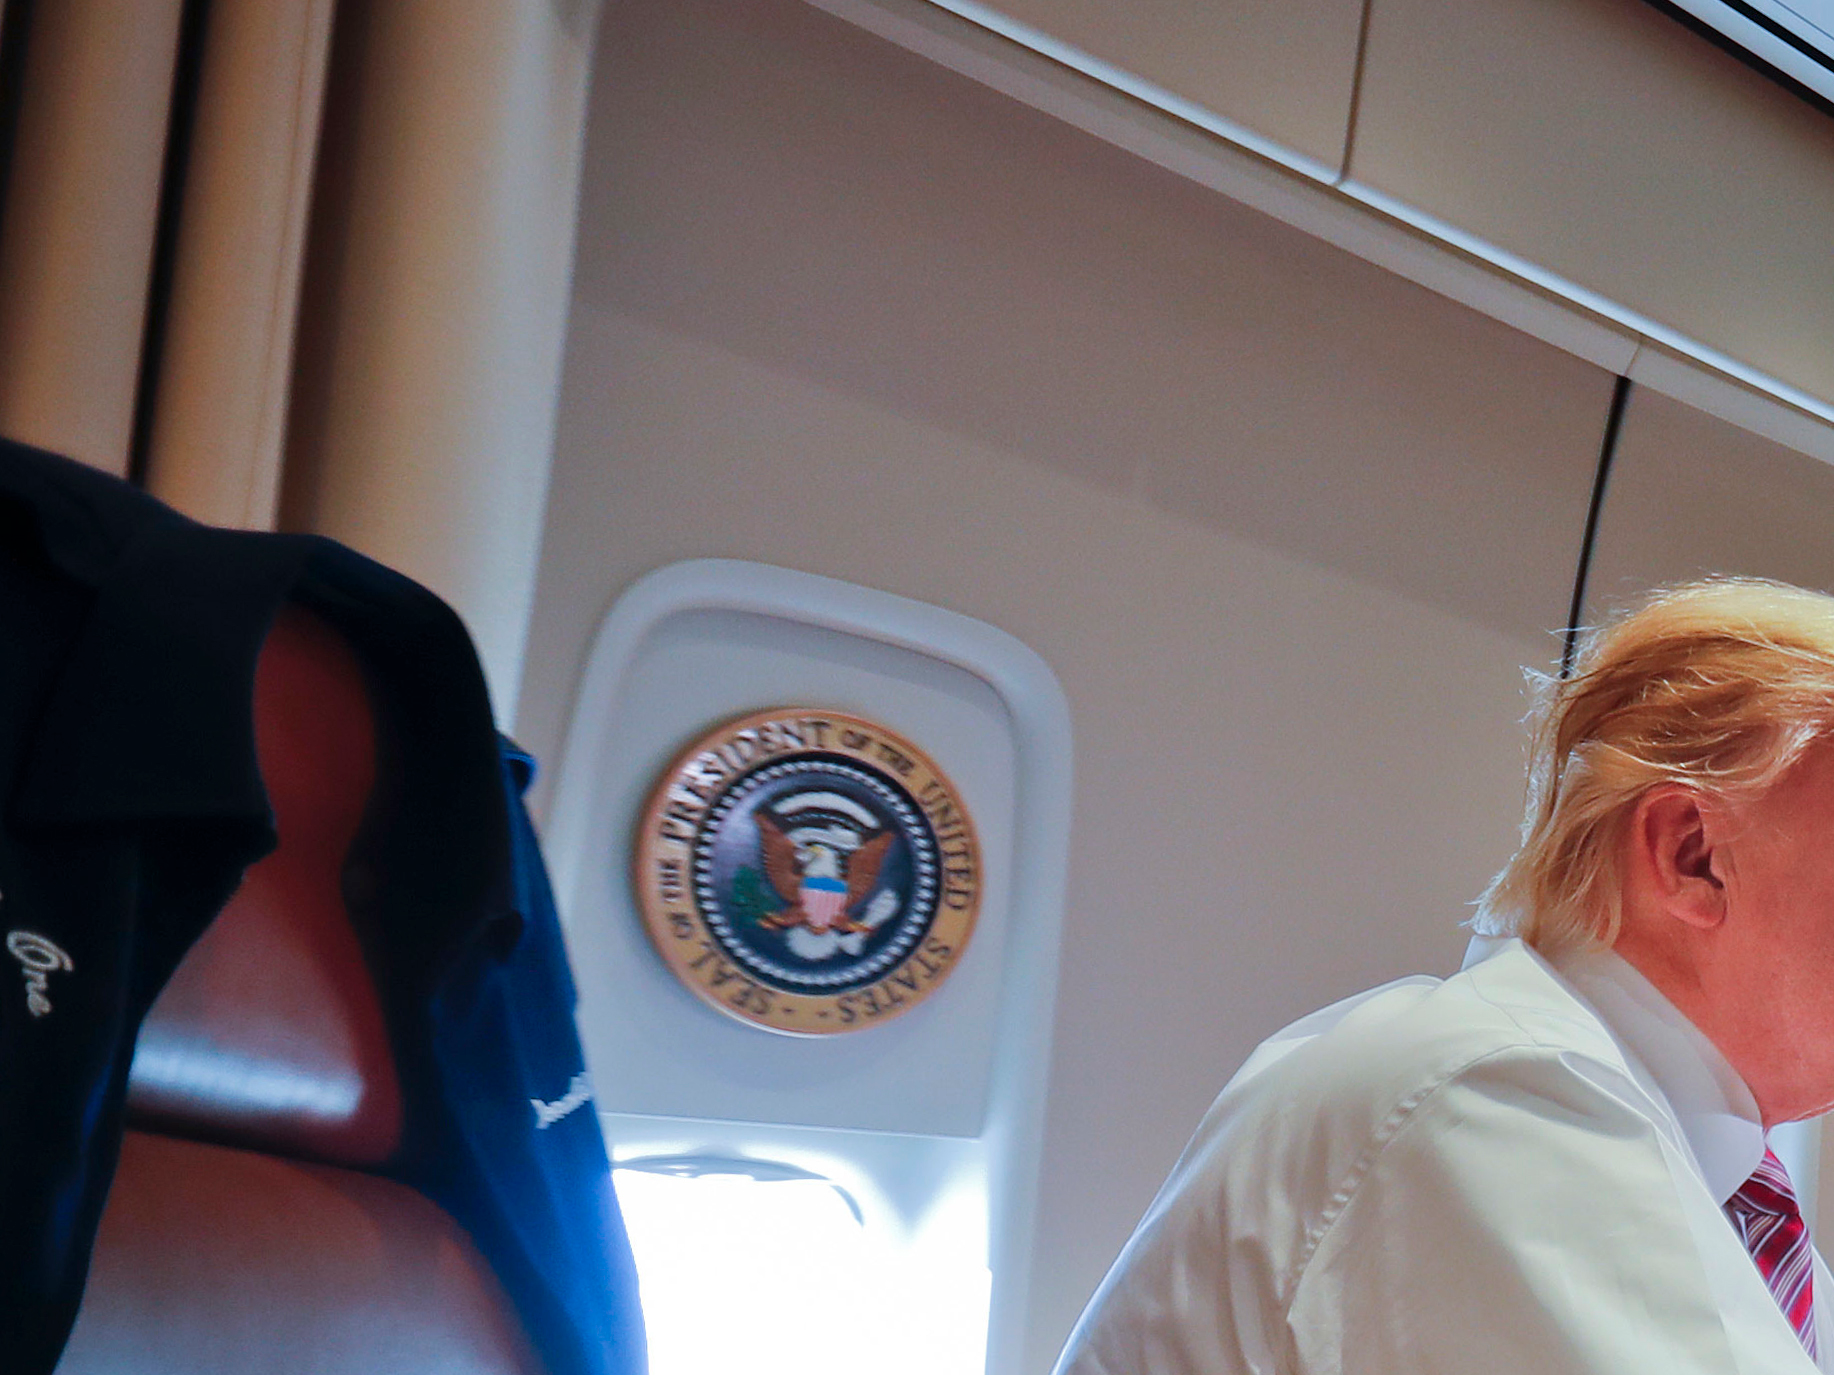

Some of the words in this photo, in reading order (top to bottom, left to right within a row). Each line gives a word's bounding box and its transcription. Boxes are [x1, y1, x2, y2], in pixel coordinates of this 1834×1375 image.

[843, 727, 870, 750] OF
[877, 745, 916, 777] THE
[660, 718, 830, 844] PRESIDENT
[658, 857, 684, 903] THE
[919, 780, 975, 912] UNITED
[667, 909, 697, 941] OF
[6, 930, 75, 1018] One
[688, 942, 777, 1016] SEAL
[838, 936, 952, 1024] STATES
